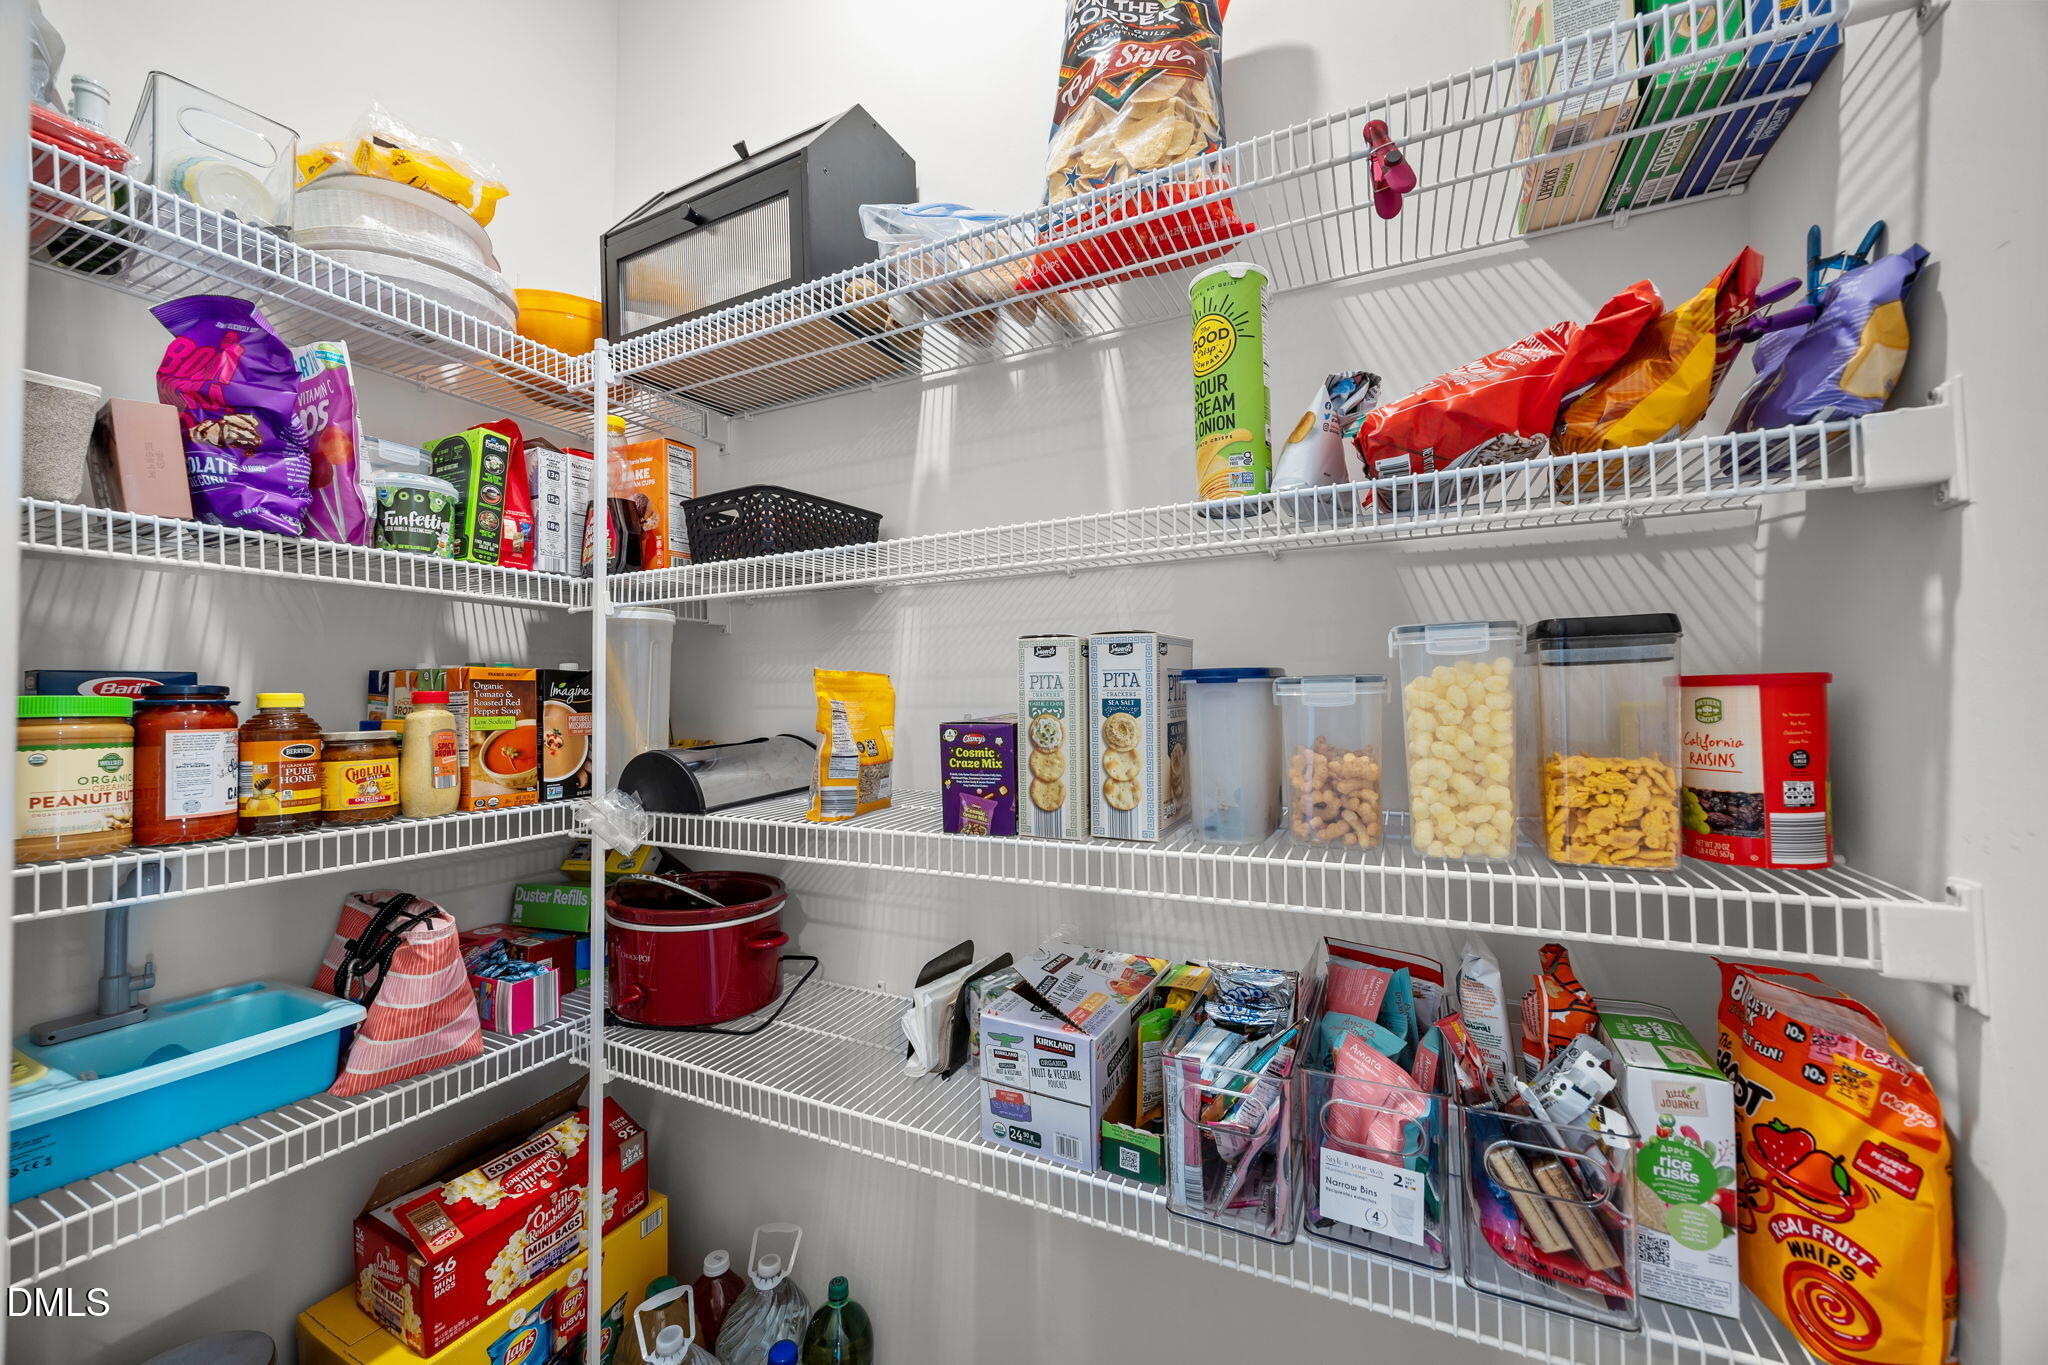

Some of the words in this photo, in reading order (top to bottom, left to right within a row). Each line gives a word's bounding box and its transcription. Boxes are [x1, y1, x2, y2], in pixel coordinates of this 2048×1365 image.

[1114, 0, 1160, 14] THE
[1068, 7, 1181, 40] BORDER
[1076, 22, 1129, 50] MEXICAN
[1115, 43, 1196, 68] Style
[1193, 328, 1230, 353] GOOD
[1195, 374, 1228, 402] SOUR
[1200, 413, 1236, 438] ONION
[383, 511, 442, 530] Funfetti
[473, 681, 504, 690] Organic
[1029, 675, 1063, 690] PITA
[1102, 673, 1140, 688] PITA
[473, 690, 504, 698] Tomato
[505, 690, 514, 698] &
[473, 698, 503, 706] Roasted
[505, 698, 521, 706] Red
[473, 707, 499, 716] Pepper
[501, 706, 521, 716] Soup
[1683, 731, 1744, 751] California
[435, 749, 456, 757] BROWN
[956, 747, 995, 758] Cosmic
[1690, 751, 1735, 768] RAISINS
[286, 767, 314, 775] PURE
[949, 758, 980, 768] Craze
[981, 758, 1003, 769] Mix
[78, 773, 132, 785] ORGANIC
[280, 774, 317, 784] HONEY
[345, 764, 391, 783] CHOLULA
[29, 792, 112, 809] PEANUT
[515, 886, 551, 903] Duster
[553, 889, 587, 906] Refills
[1368, 977, 1384, 1006] Amara
[1720, 1032, 1732, 1049] The
[1785, 1023, 1805, 1042] 10x
[1035, 1036, 1074, 1051] KIRKLAND
[995, 1050, 1018, 1058] KIRKLAND
[1350, 1043, 1384, 1072] Amara
[1031, 1068, 1046, 1078] FRUIT
[1053, 1069, 1081, 1080] VEGETABLE
[1803, 1065, 1827, 1084] 10x
[1047, 1080, 1067, 1090] POUCHES
[1665, 1090, 1690, 1100] little
[1661, 1099, 1700, 1110] JOURNEY
[1010, 1127, 1023, 1142] 24
[521, 1134, 552, 1158] MINI
[1660, 1145, 1690, 1156] APPLE
[487, 1152, 520, 1177] BAGS
[1659, 1155, 1692, 1171] rice
[1870, 1150, 1913, 1175] PERFECT
[1878, 1161, 1899, 1177] FOR
[516, 1158, 562, 1194] Orville
[1393, 1174, 1404, 1188] 2
[1653, 1166, 1700, 1184] rusks
[1325, 1176, 1357, 1192] Narrow
[1360, 1185, 1378, 1198] Bins
[533, 1189, 575, 1228] Orville
[1372, 1211, 1380, 1221] 4
[526, 1195, 582, 1242] Redenbacher's
[527, 1235, 554, 1259] MINI
[554, 1215, 582, 1245] BAGS
[376, 1252, 400, 1275] Orville
[433, 1256, 457, 1280] 36
[1786, 1240, 1857, 1282] WHIPS
[434, 1274, 456, 1292] MINI
[434, 1282, 456, 1299] BAGS
[373, 1279, 387, 1297] MINI
[387, 1290, 403, 1311] BAGS
[562, 1289, 585, 1316] Lay's
[560, 1308, 586, 1332] wavy
[505, 1332, 537, 1365] Lay's
